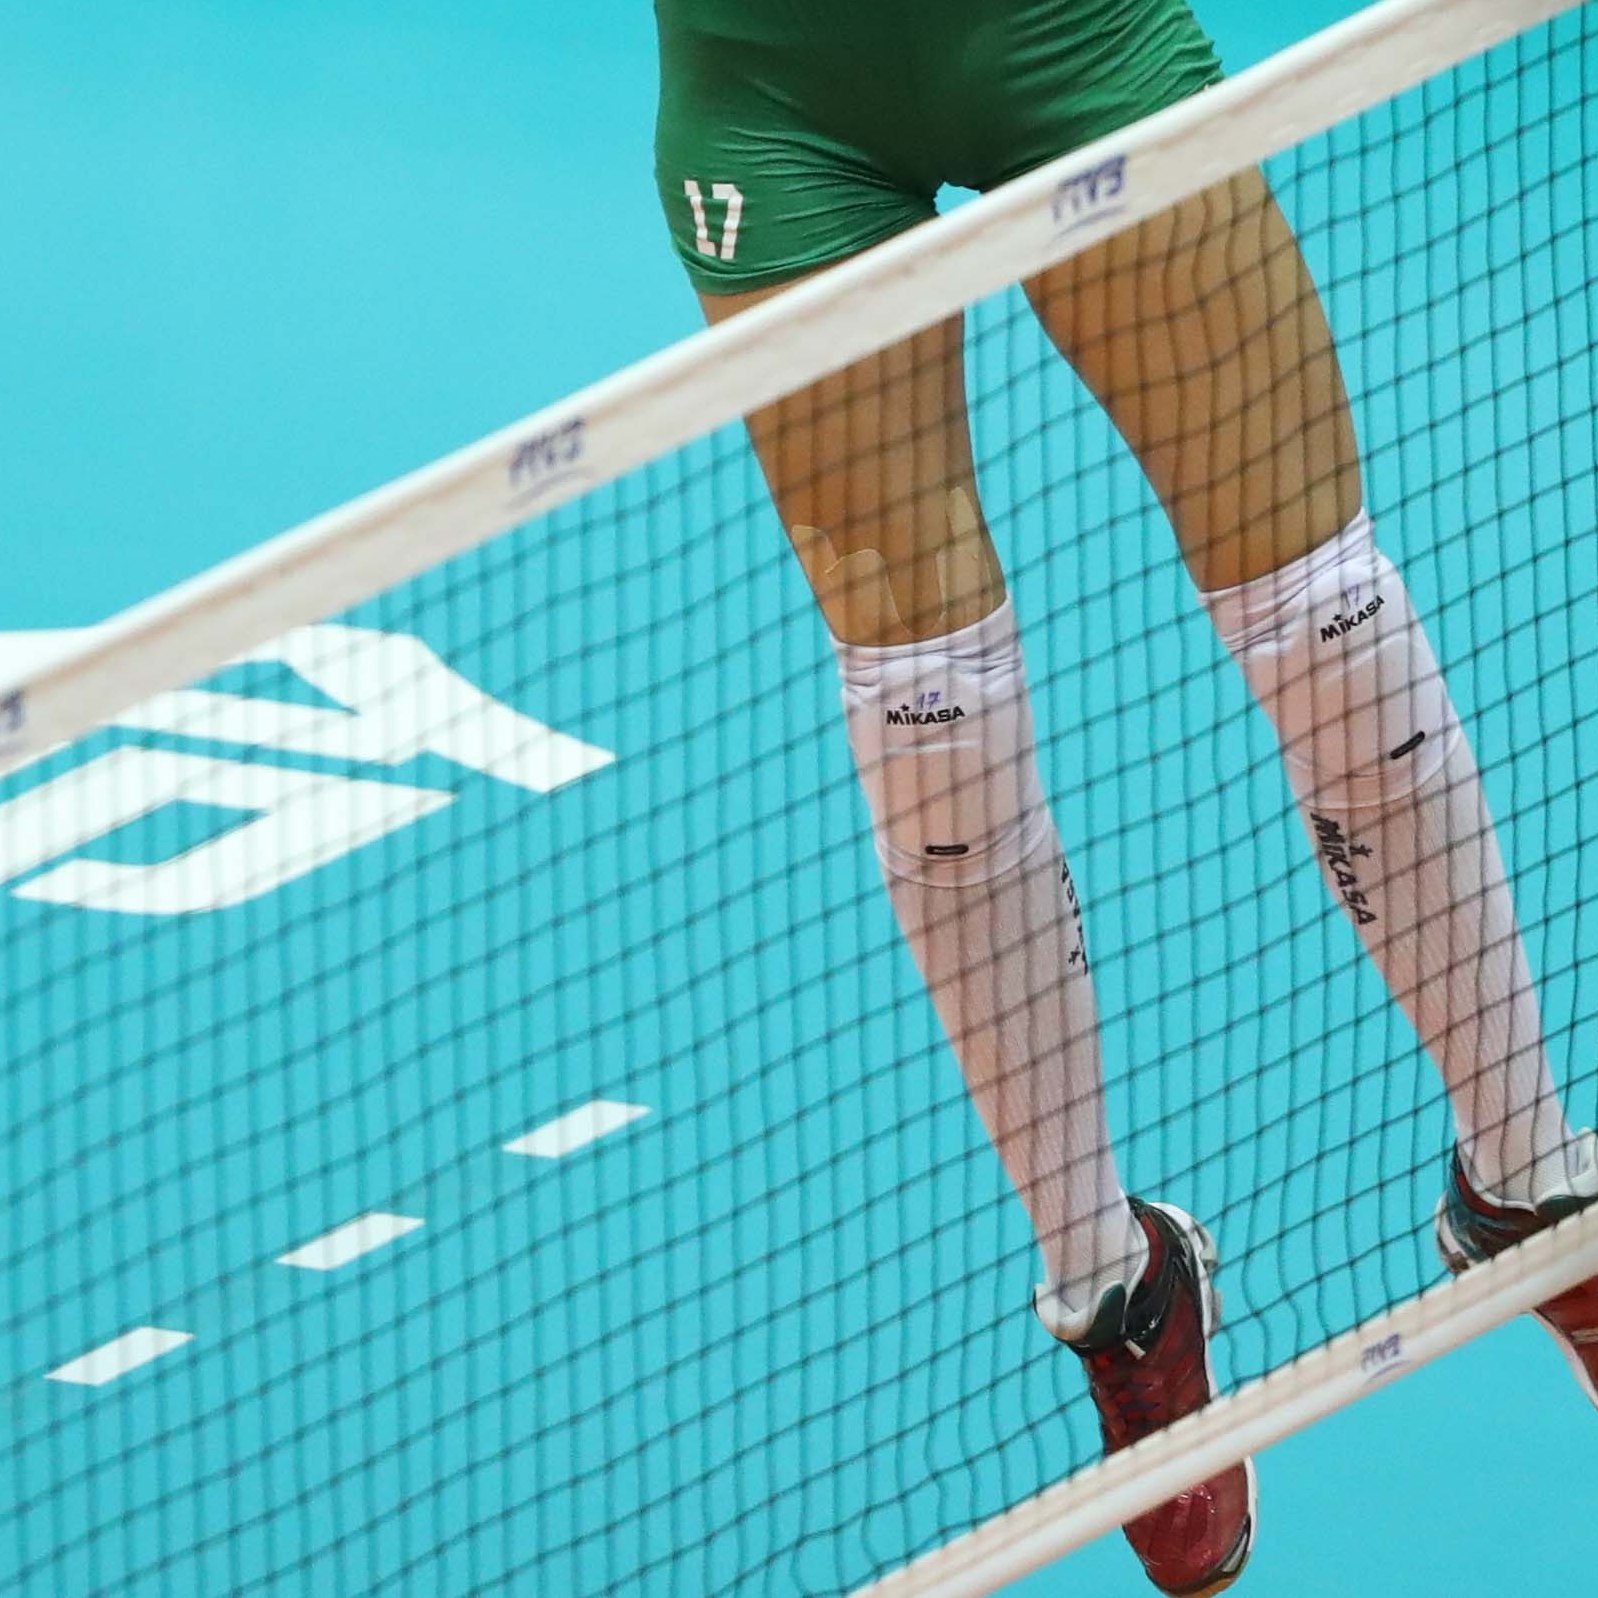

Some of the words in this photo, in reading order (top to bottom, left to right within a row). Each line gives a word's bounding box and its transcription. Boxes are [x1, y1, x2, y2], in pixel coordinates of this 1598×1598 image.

[683, 179, 744, 260] 17
[1320, 594, 1385, 643] MIKASA
[886, 705, 965, 725] MIKASA
